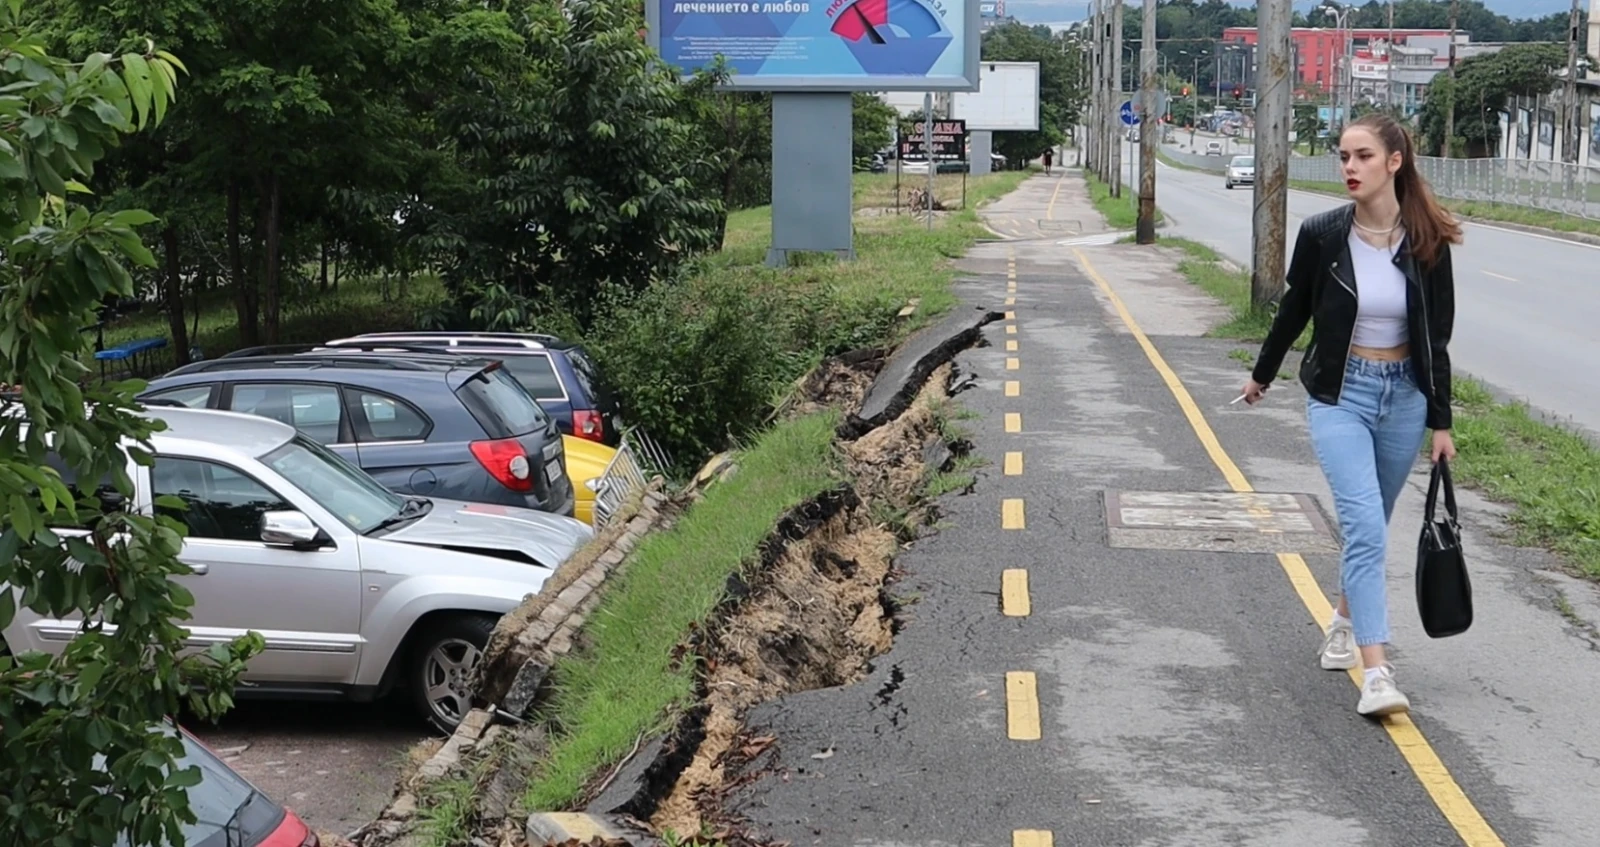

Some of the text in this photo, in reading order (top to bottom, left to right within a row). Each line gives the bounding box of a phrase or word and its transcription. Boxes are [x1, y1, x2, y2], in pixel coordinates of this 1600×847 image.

[673, 0, 810, 13] лечението е любов
